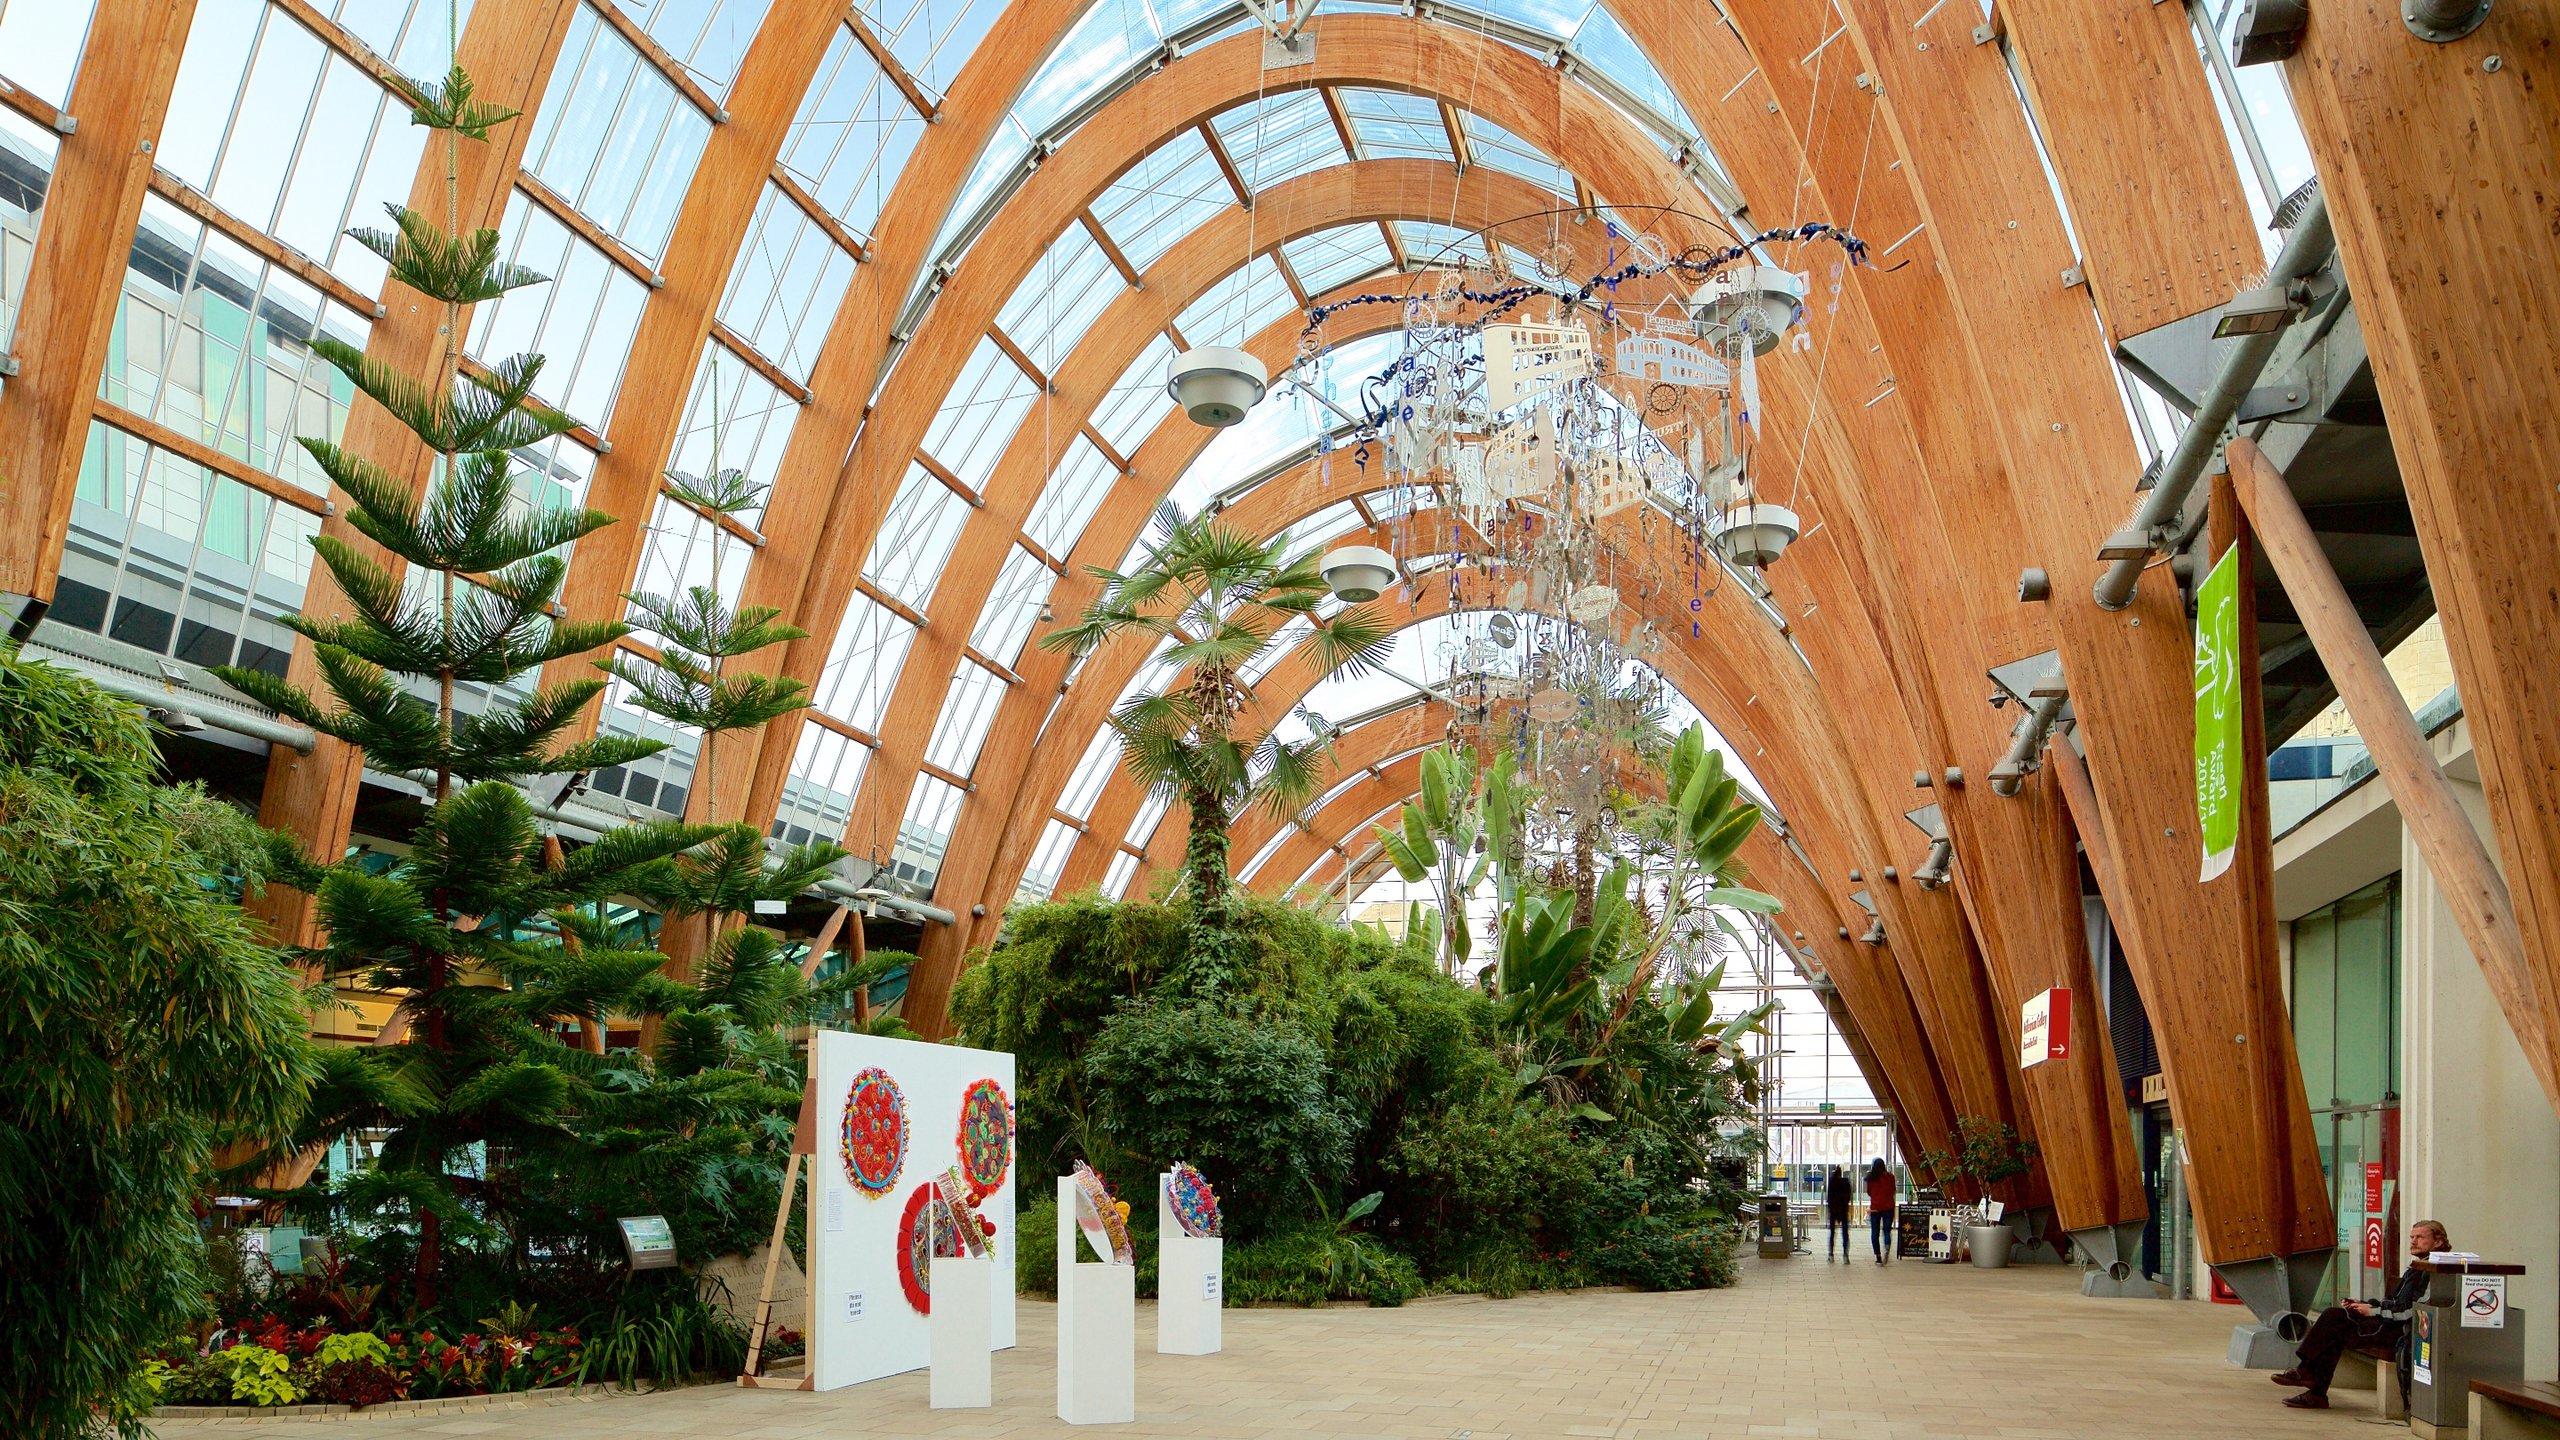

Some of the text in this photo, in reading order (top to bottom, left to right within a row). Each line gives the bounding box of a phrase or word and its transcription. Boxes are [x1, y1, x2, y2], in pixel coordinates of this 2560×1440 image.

[1649, 316, 1694, 328] PORTLAND
[1656, 325, 1687, 335] WORKS
[2208, 751, 2218, 817] Award
[752, 1258, 792, 1275] GAEN
